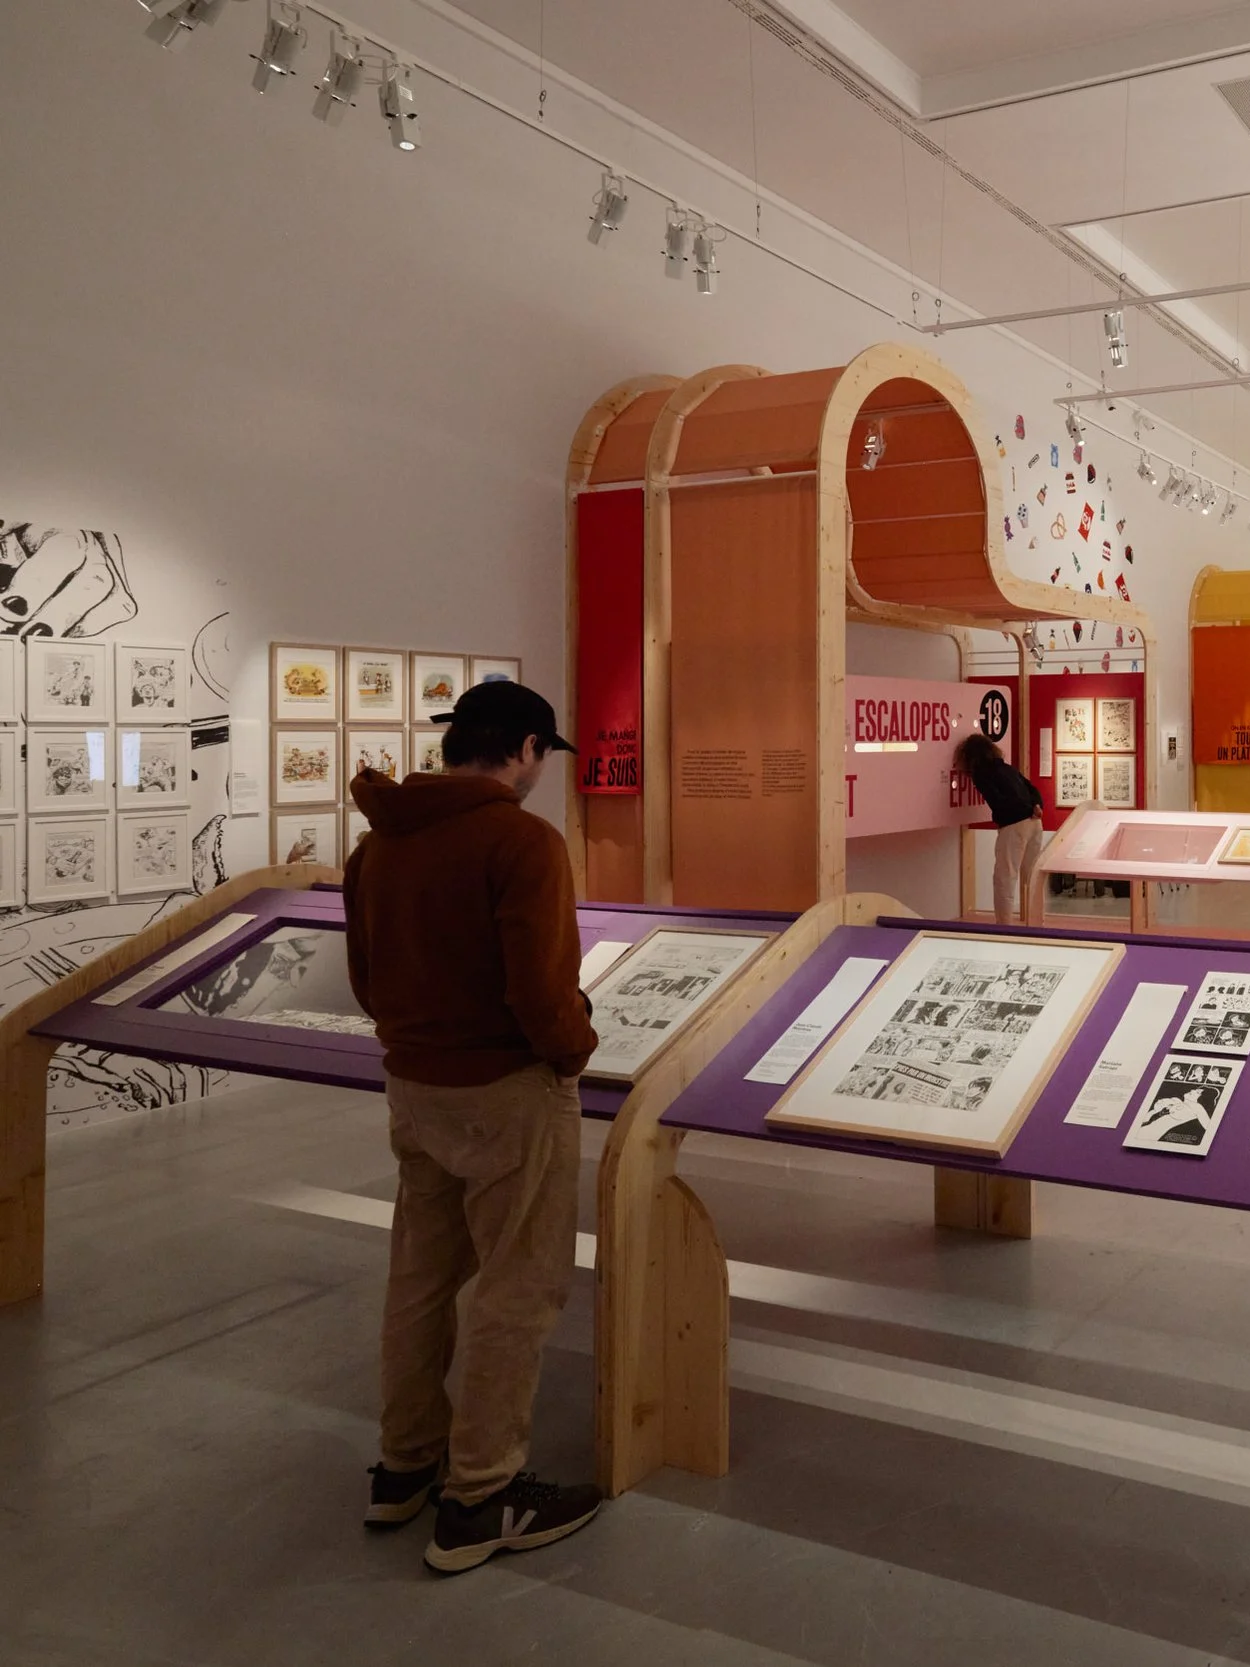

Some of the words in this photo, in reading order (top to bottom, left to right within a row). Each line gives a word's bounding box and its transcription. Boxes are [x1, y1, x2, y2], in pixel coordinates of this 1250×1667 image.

[855, 699, 950, 742] ESCALOPES
[979, 698, 1002, 736] -18
[1217, 746, 1228, 760] UN
[1231, 746, 1250, 760] PLAT
[583, 757, 603, 787] JE
[607, 757, 638, 787] SUIS
